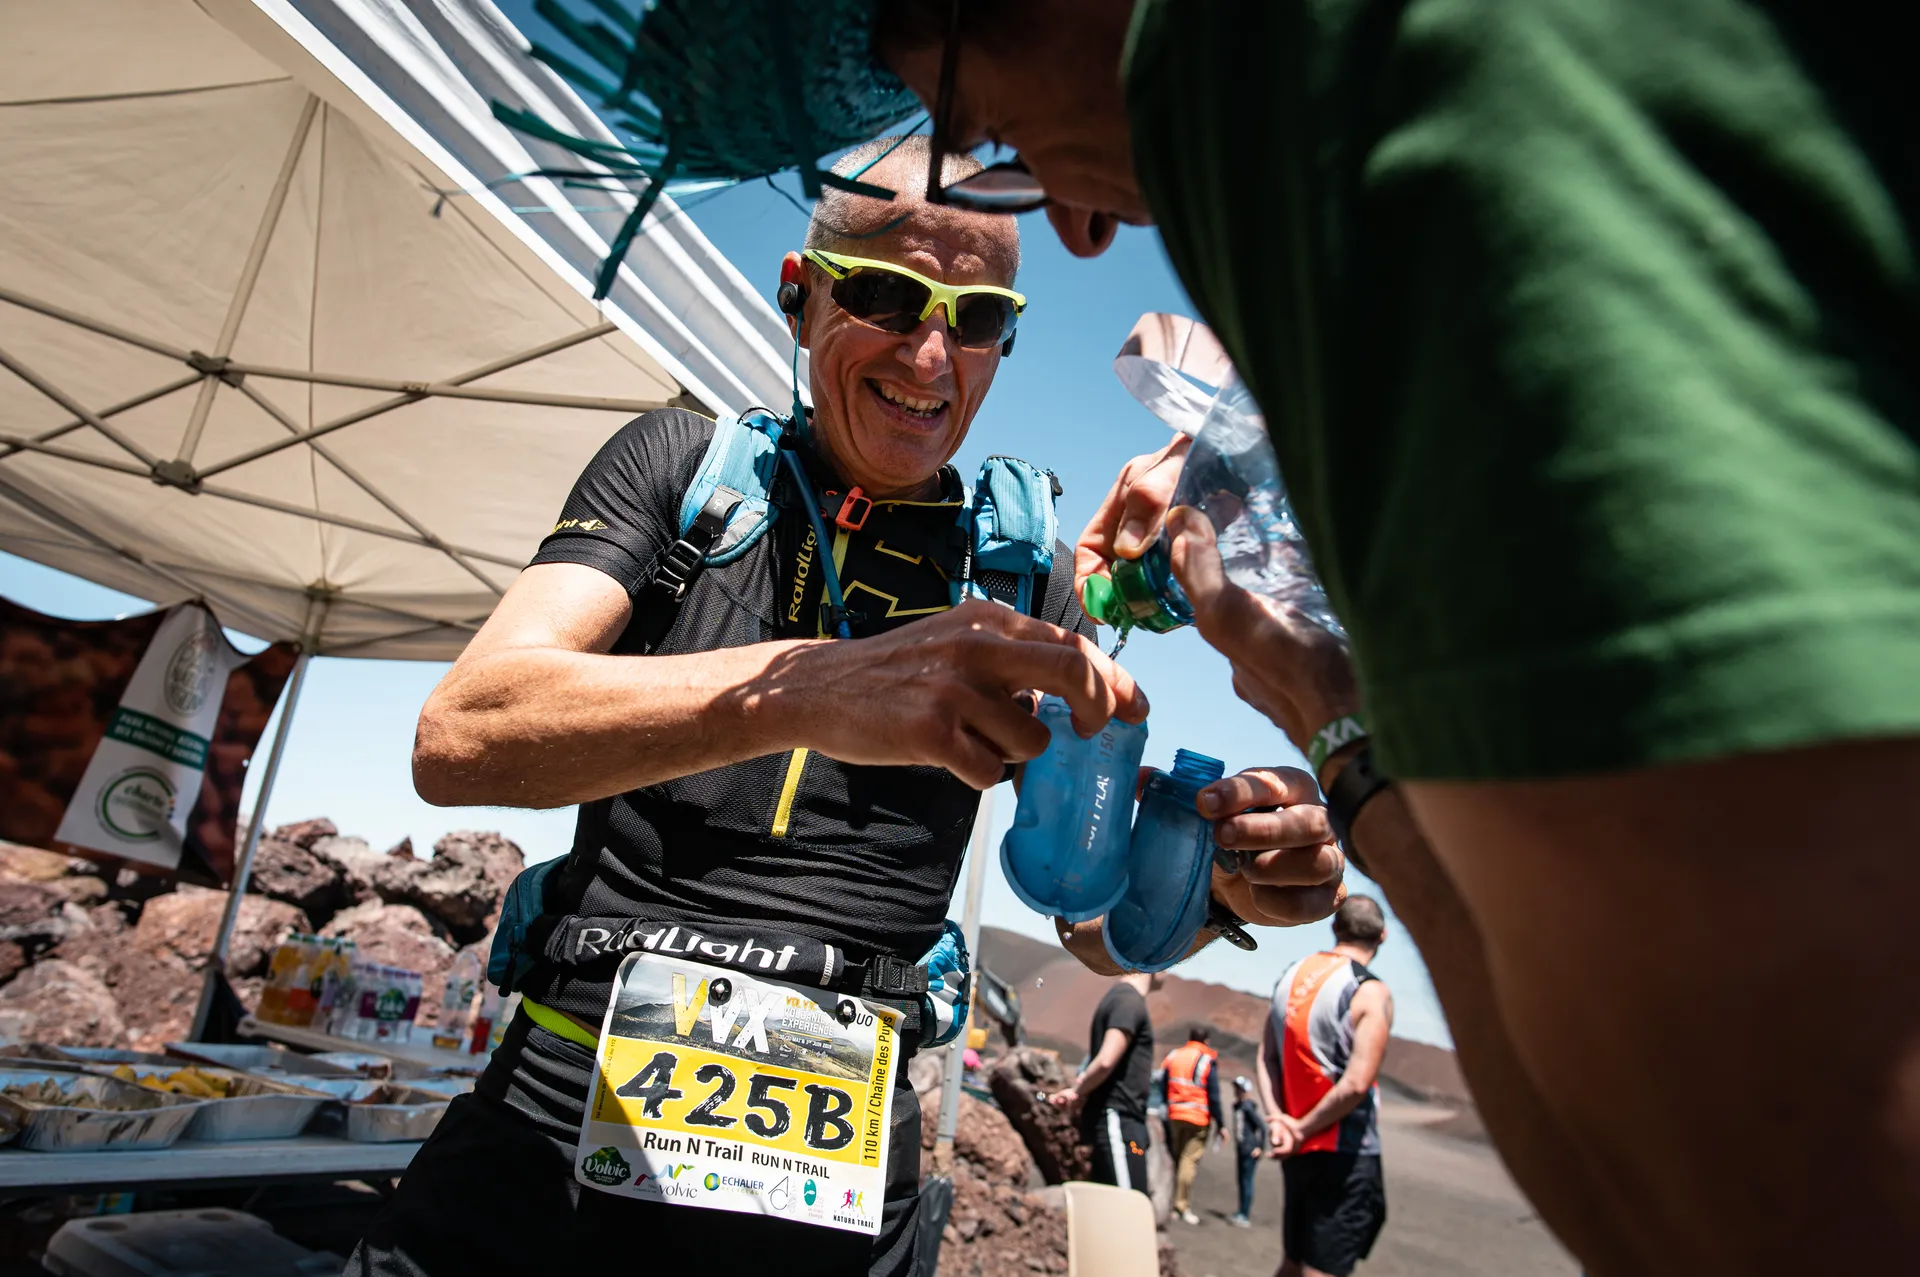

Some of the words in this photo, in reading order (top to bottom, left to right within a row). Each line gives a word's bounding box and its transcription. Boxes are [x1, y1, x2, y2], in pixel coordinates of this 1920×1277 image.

[1100, 732, 1115, 758] 150
[781, 1016, 835, 1036] EXPERIENCE
[878, 1015, 894, 1043] Puys
[876, 1045, 889, 1066] des
[869, 1069, 886, 1108] Chaîne
[615, 1051, 855, 1150] 425B
[867, 1109, 881, 1118] /
[866, 1118, 880, 1138] km
[643, 1131, 681, 1152] Run
[686, 1137, 701, 1155] N
[704, 1140, 743, 1162] Trail
[751, 1152, 780, 1169] RUN
[783, 1157, 792, 1171] N
[795, 1160, 830, 1179] TRAIL
[864, 1140, 878, 1161] 110
[585, 1158, 628, 1178] Volvic
[658, 1182, 698, 1198] volvic
[721, 1176, 764, 1190] ECHALIER
[833, 1214, 856, 1225] NATURA
[857, 1218, 874, 1229] TRAIL
